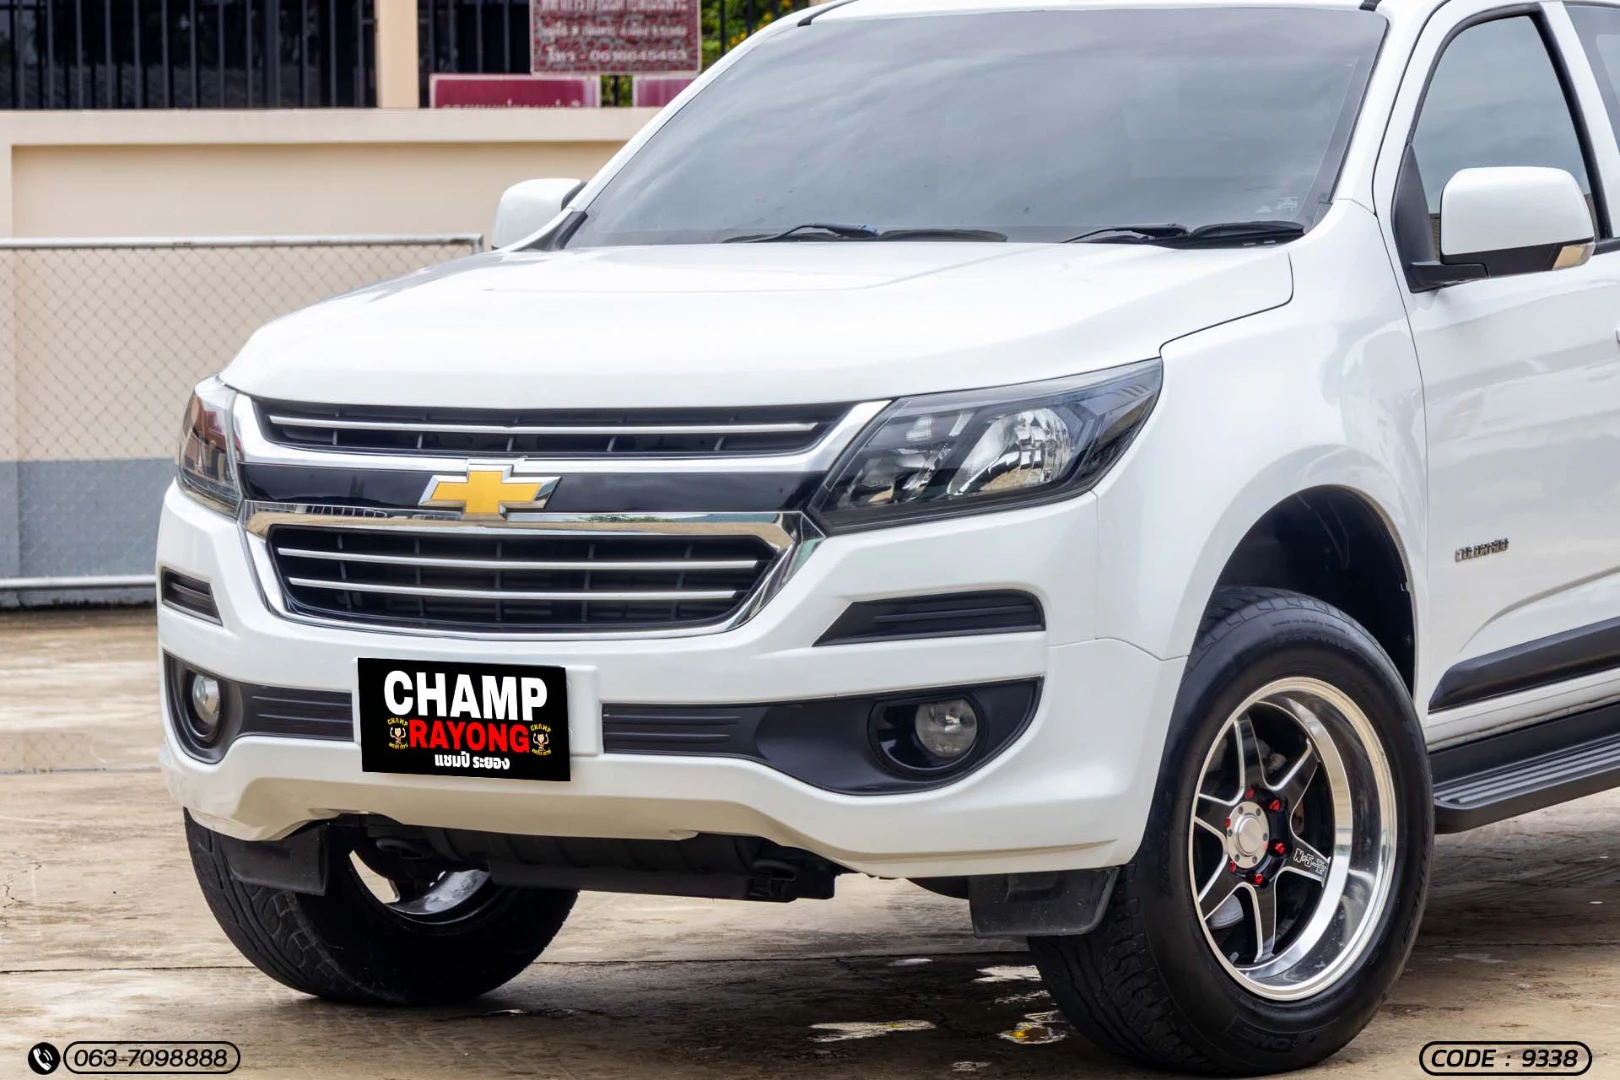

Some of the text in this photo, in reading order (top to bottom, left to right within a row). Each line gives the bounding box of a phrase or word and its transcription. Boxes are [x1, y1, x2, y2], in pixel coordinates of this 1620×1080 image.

[384, 670, 548, 721] CHAMP
[408, 718, 530, 754] RAYONG
[472, 756, 511, 770] ระยอง
